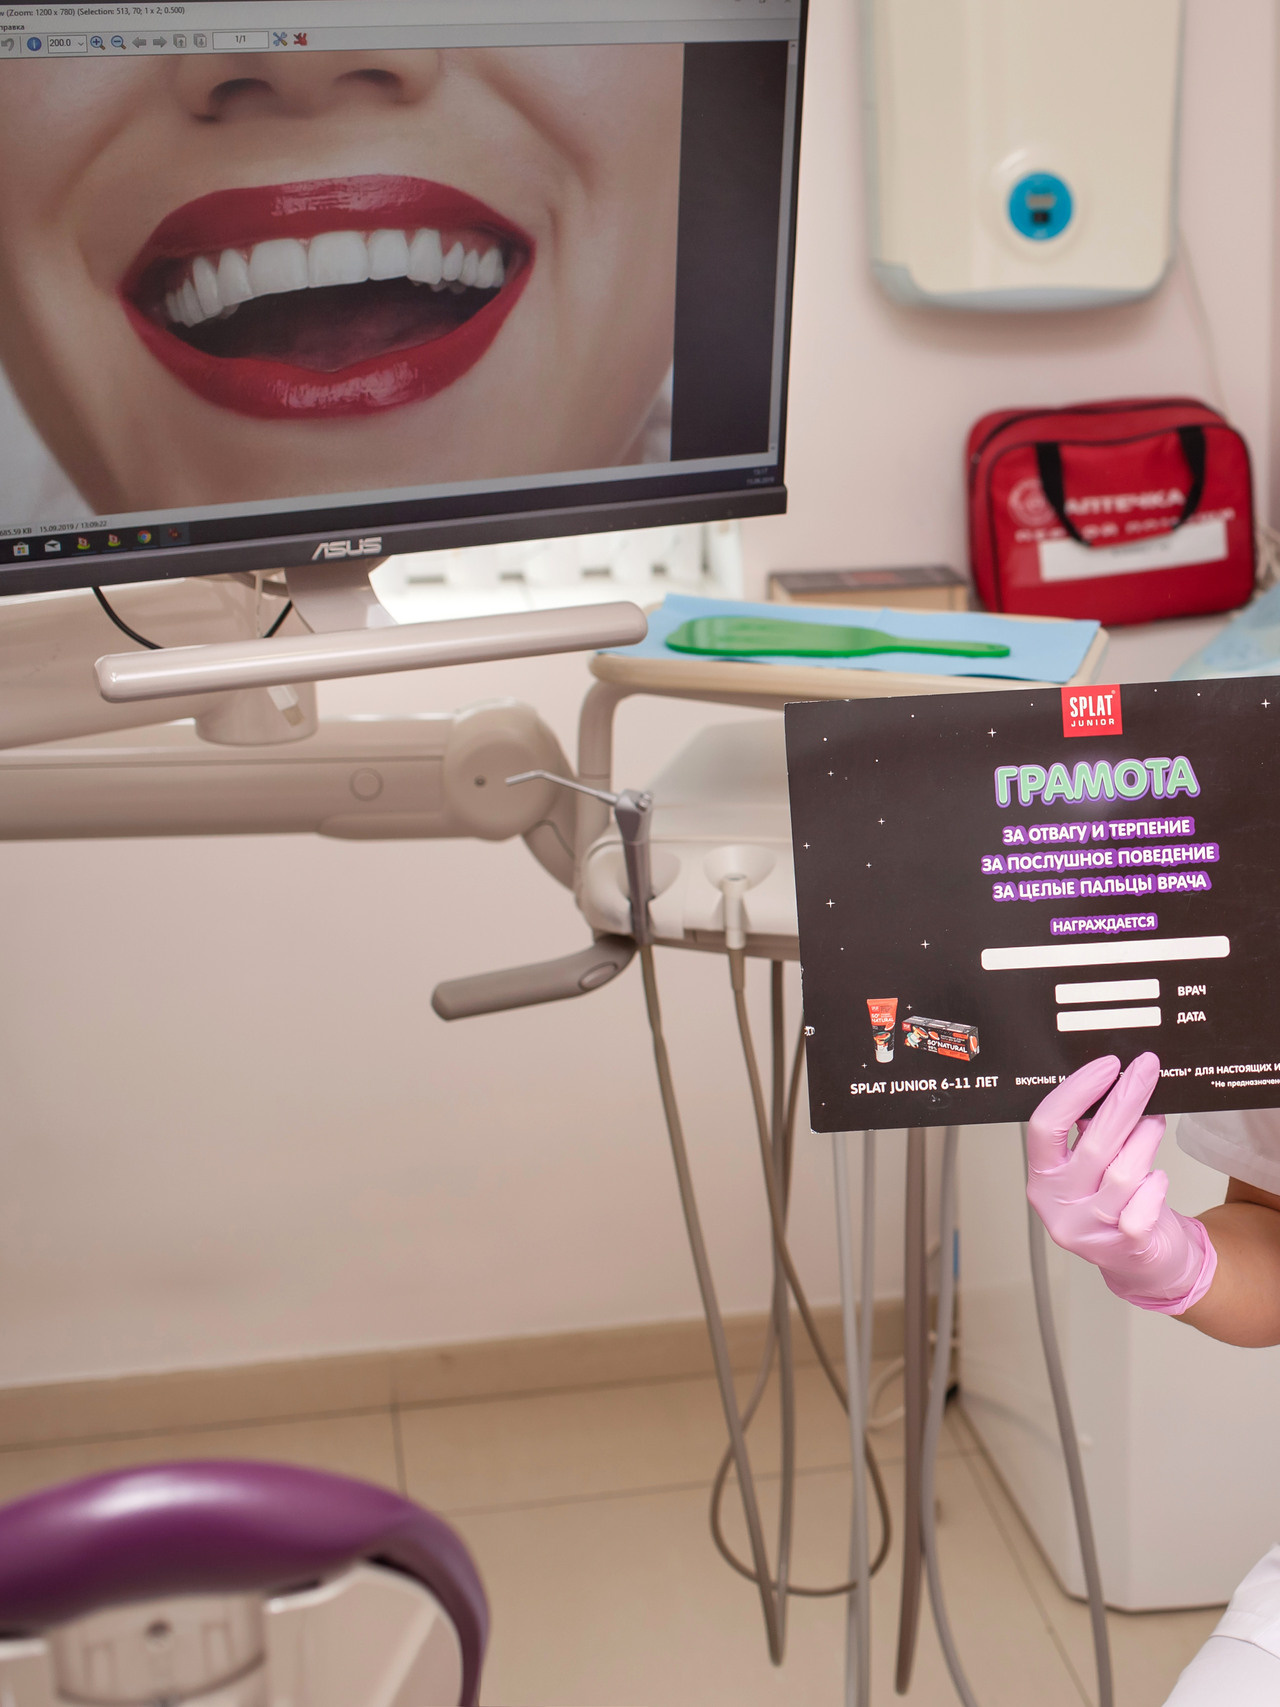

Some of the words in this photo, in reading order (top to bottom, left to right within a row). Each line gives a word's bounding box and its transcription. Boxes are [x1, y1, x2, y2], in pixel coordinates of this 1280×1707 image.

[6, 9, 34, 17] (Zoom:
[60, 8, 76, 17] 780)
[77, 8, 114, 17] (Selection:
[117, 8, 130, 16] 513,
[164, 7, 185, 15] 0.500)
[49, 39, 71, 47] 200.0
[235, 35, 246, 44] 1/1
[23, 527, 32, 535] KB
[311, 536, 382, 561] ASUS
[1069, 694, 1113, 718] SPLAT
[1071, 718, 1115, 727] JUNIOR
[995, 756, 1200, 806] ГРАМОТА
[1003, 828, 1024, 843] ЗА
[1028, 825, 1087, 841] ОТВАГУ
[1092, 824, 1105, 838] И
[1109, 820, 1190, 837] ТЕРПЕНИЕ
[982, 857, 1003, 872] ЗА
[1008, 852, 1113, 871] ПОСЛУШНОЕ
[1118, 846, 1215, 865] ПОВЕДЕНИЕ
[993, 885, 1014, 900] ЗА
[1020, 881, 1075, 899] ЦЕЛЫЕ
[1080, 878, 1151, 894] ПАЛЬЦЫ
[1158, 874, 1207, 890] ВРАЧА
[1053, 916, 1155, 933] НАГРАЖДАЕТСЯ
[1177, 985, 1206, 996] ВРАЧ
[1176, 1011, 1206, 1024] ДАТА
[1015, 1075, 1057, 1086] ВКУСНЫЕ
[1058, 1075, 1066, 1084] И
[1195, 1066, 1215, 1077] ДЛЯ
[1216, 1063, 1272, 1075] НАСТОЯЩИХ
[850, 1081, 887, 1095] SPLAT
[890, 1079, 937, 1094] JUNIOR
[940, 1077, 970, 1090] 6-11
[974, 1075, 999, 1088] ЛЕТ
